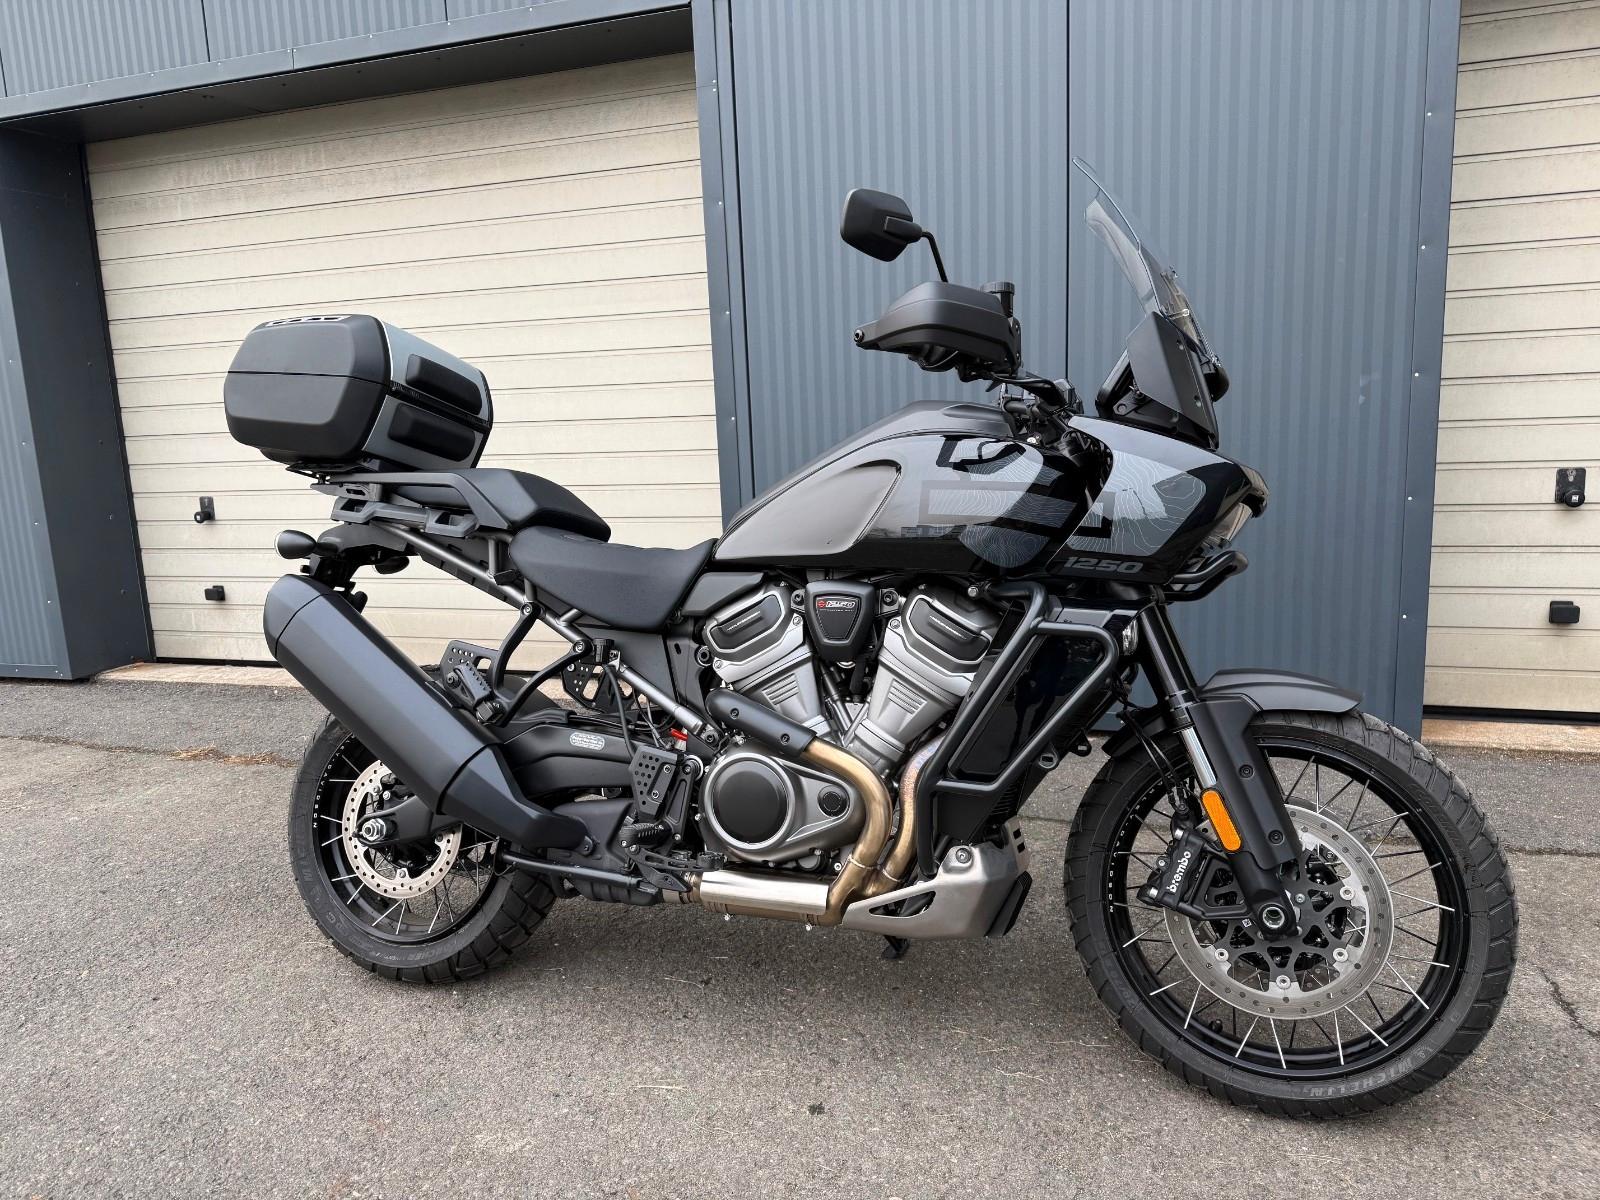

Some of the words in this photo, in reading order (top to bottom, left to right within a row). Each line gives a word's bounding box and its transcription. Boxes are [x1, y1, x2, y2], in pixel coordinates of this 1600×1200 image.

[1064, 556, 1144, 574] 1250
[1166, 851, 1192, 893] brembo
[1308, 1057, 1413, 1098] MICHELIN
